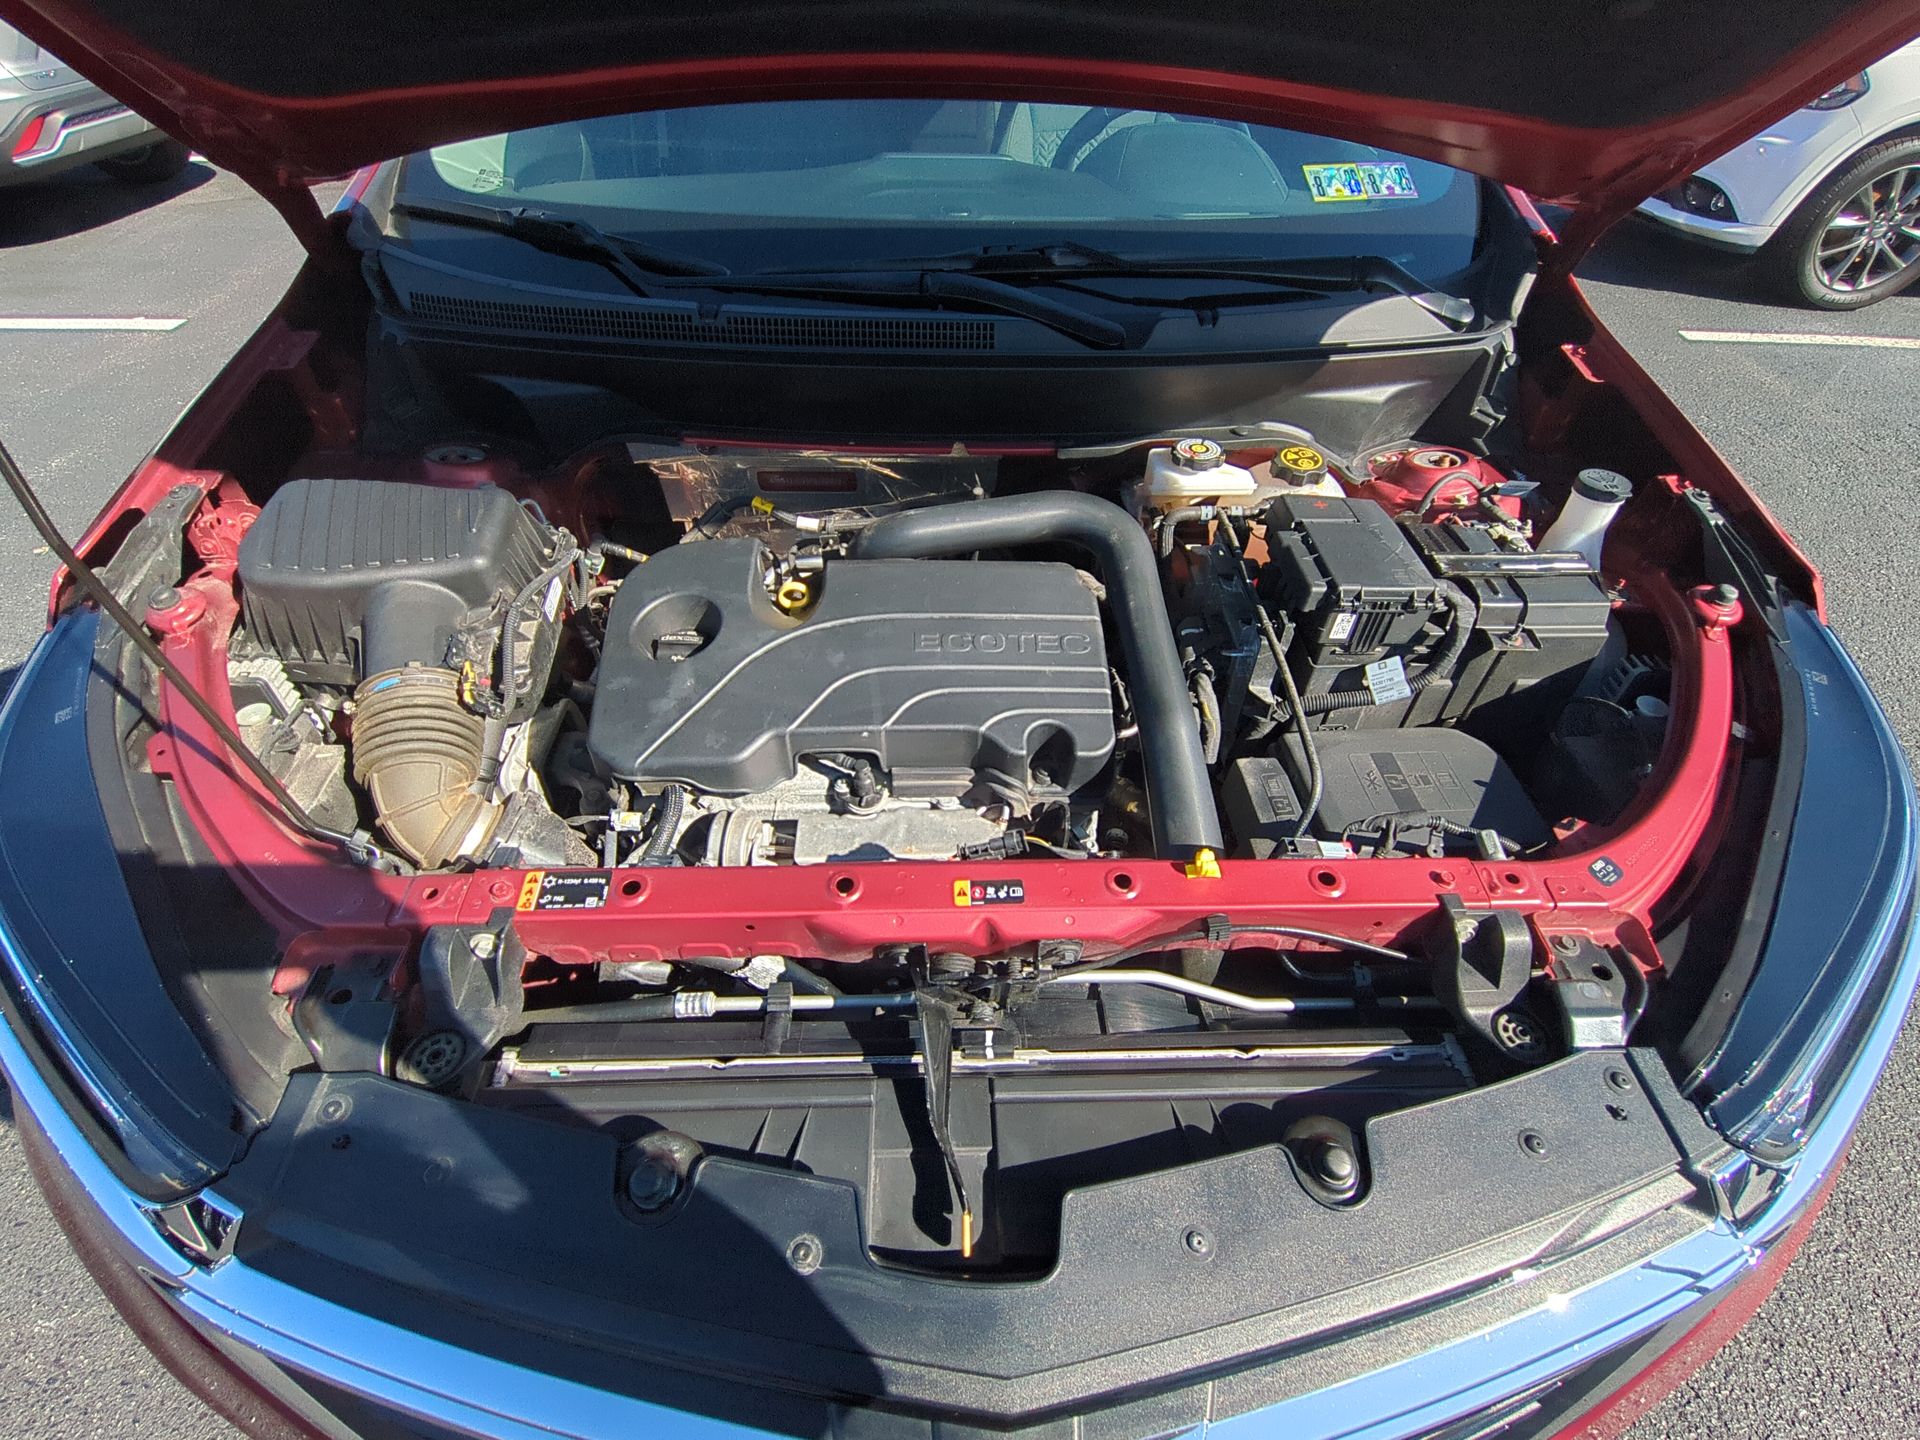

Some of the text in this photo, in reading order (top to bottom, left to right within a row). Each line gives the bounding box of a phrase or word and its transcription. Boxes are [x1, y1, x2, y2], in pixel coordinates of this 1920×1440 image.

[1313, 176, 1326, 197] 8
[1367, 173, 1380, 194] 8
[913, 632, 1092, 654] ECOTEC
